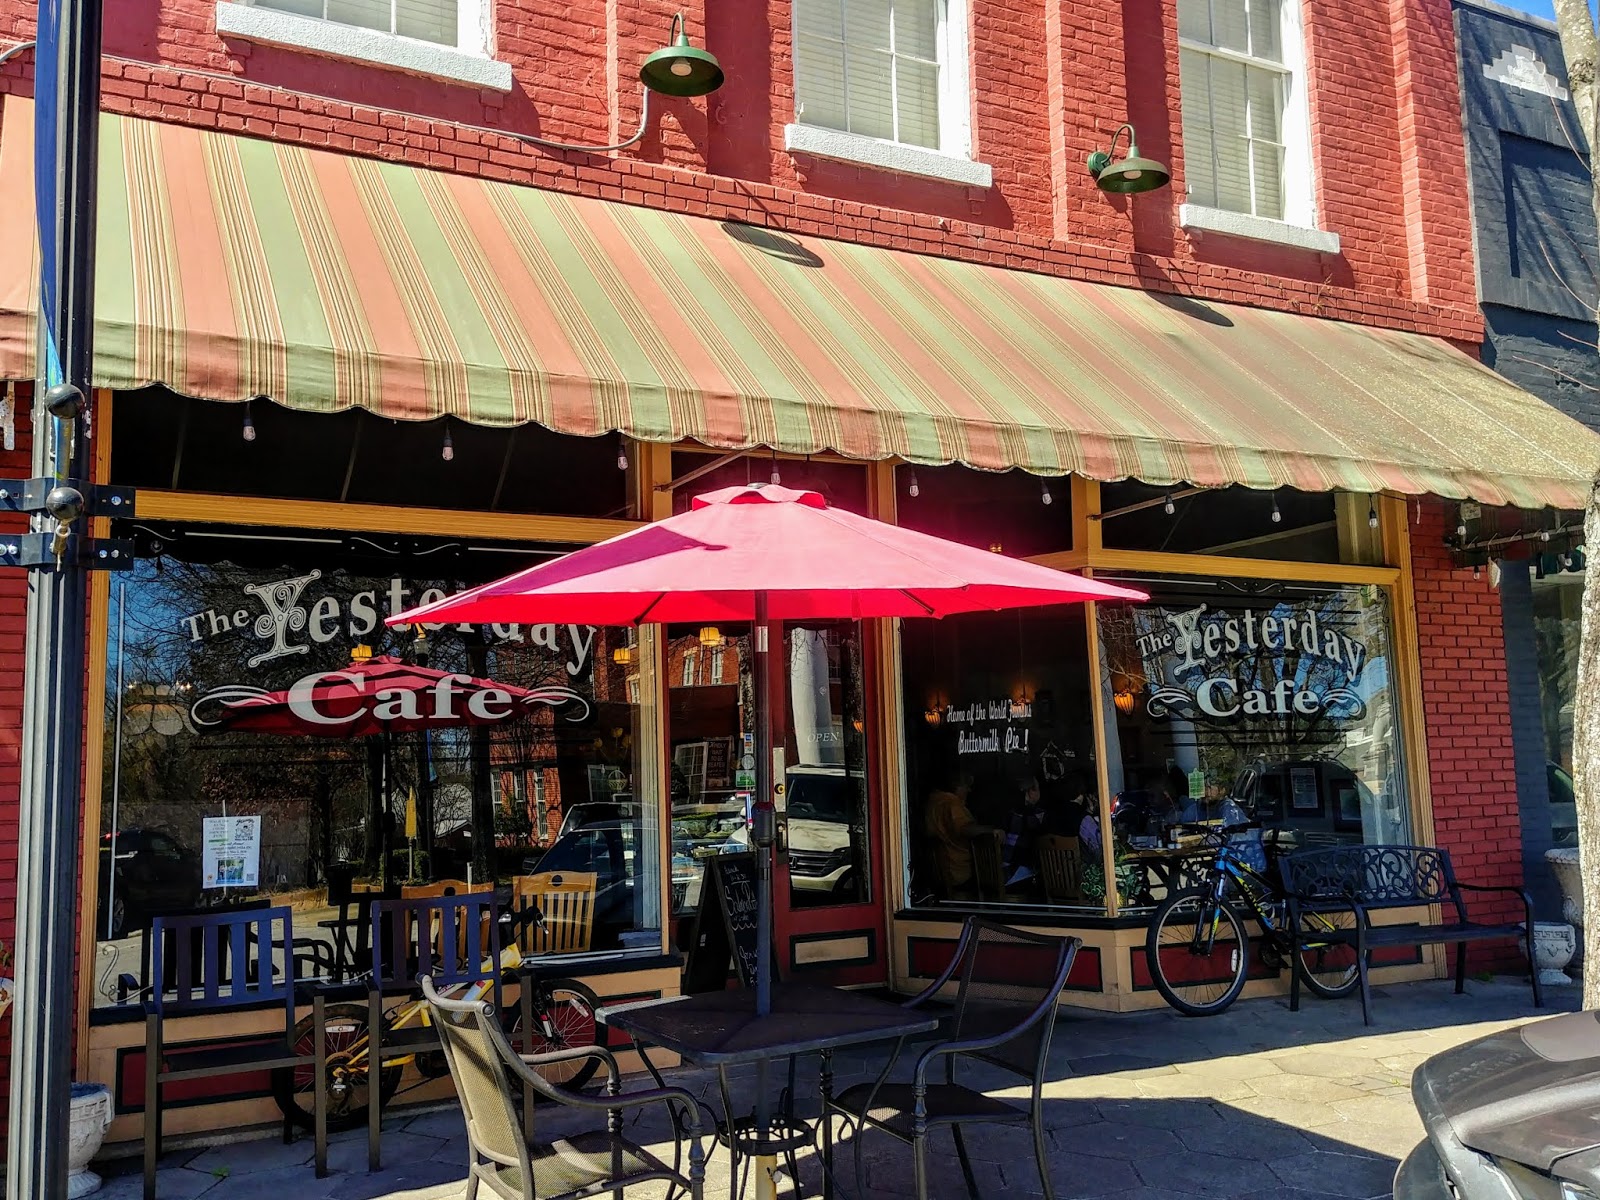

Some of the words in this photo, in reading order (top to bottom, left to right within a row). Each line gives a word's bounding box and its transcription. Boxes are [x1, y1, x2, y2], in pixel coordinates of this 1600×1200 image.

[180, 604, 252, 643] The
[244, 569, 597, 676] Yesteay
[1136, 632, 1172, 657] The
[1167, 603, 1365, 681] Yesterday
[288, 671, 514, 724] Cafe
[947, 705, 965, 723] Home
[966, 703, 974, 726] of
[975, 703, 986, 720] the
[989, 699, 1007, 720] World
[1196, 678, 1320, 717] Cafe
[807, 731, 839, 743] OPEN
[958, 728, 999, 755] Buttermilk
